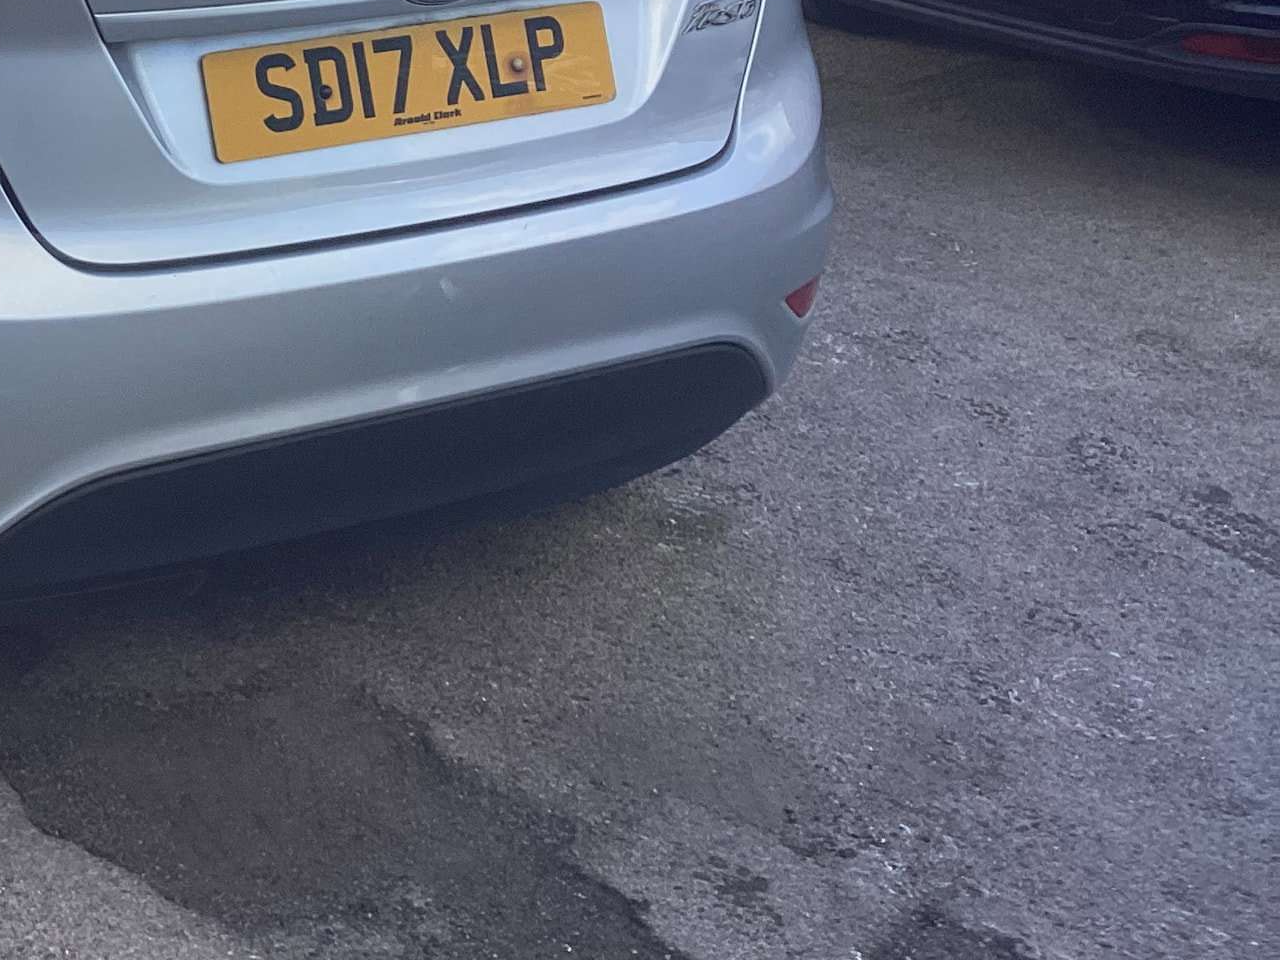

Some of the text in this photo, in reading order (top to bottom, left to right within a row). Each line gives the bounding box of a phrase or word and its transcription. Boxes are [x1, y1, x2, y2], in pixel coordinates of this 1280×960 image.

[255, 15, 565, 133] SD17 XLP
[393, 108, 462, 126] Arnold Clark
